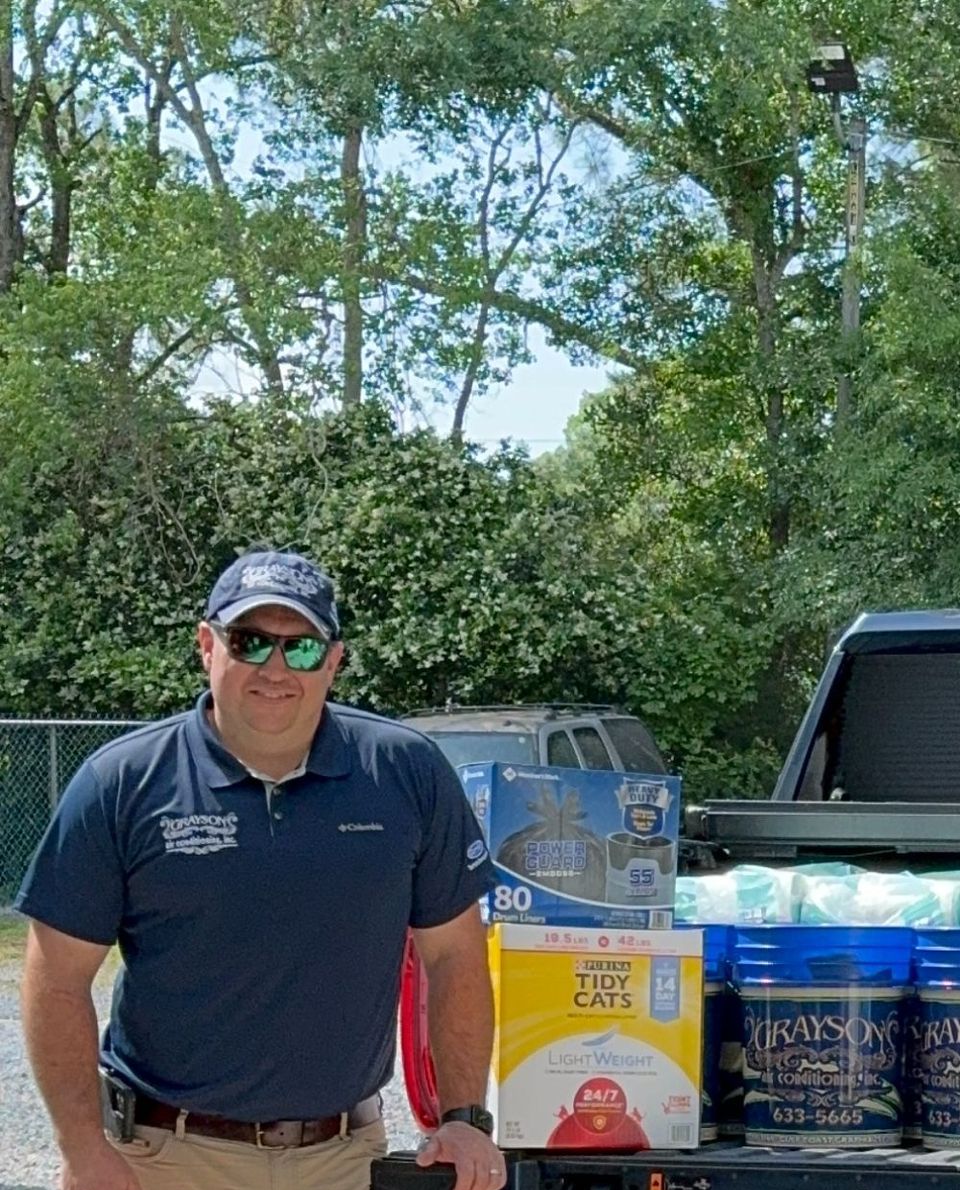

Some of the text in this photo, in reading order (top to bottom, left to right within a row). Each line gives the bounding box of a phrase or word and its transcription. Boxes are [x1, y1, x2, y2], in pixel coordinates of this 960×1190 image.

[630, 793, 659, 803] DUTY
[527, 841, 585, 855] POWER
[526, 855, 585, 870] GUARD
[629, 869, 655, 886] 55
[494, 885, 532, 912] 80
[493, 911, 546, 924] Drum Liners
[618, 935, 635, 946] 42
[585, 960, 632, 971] PURINA
[575, 973, 631, 990] TIDY
[655, 977, 676, 991] 14
[573, 992, 632, 1009] CATS
[583, 1089, 619, 1103] 24/7
[773, 1107, 863, 1124] 633-5665
